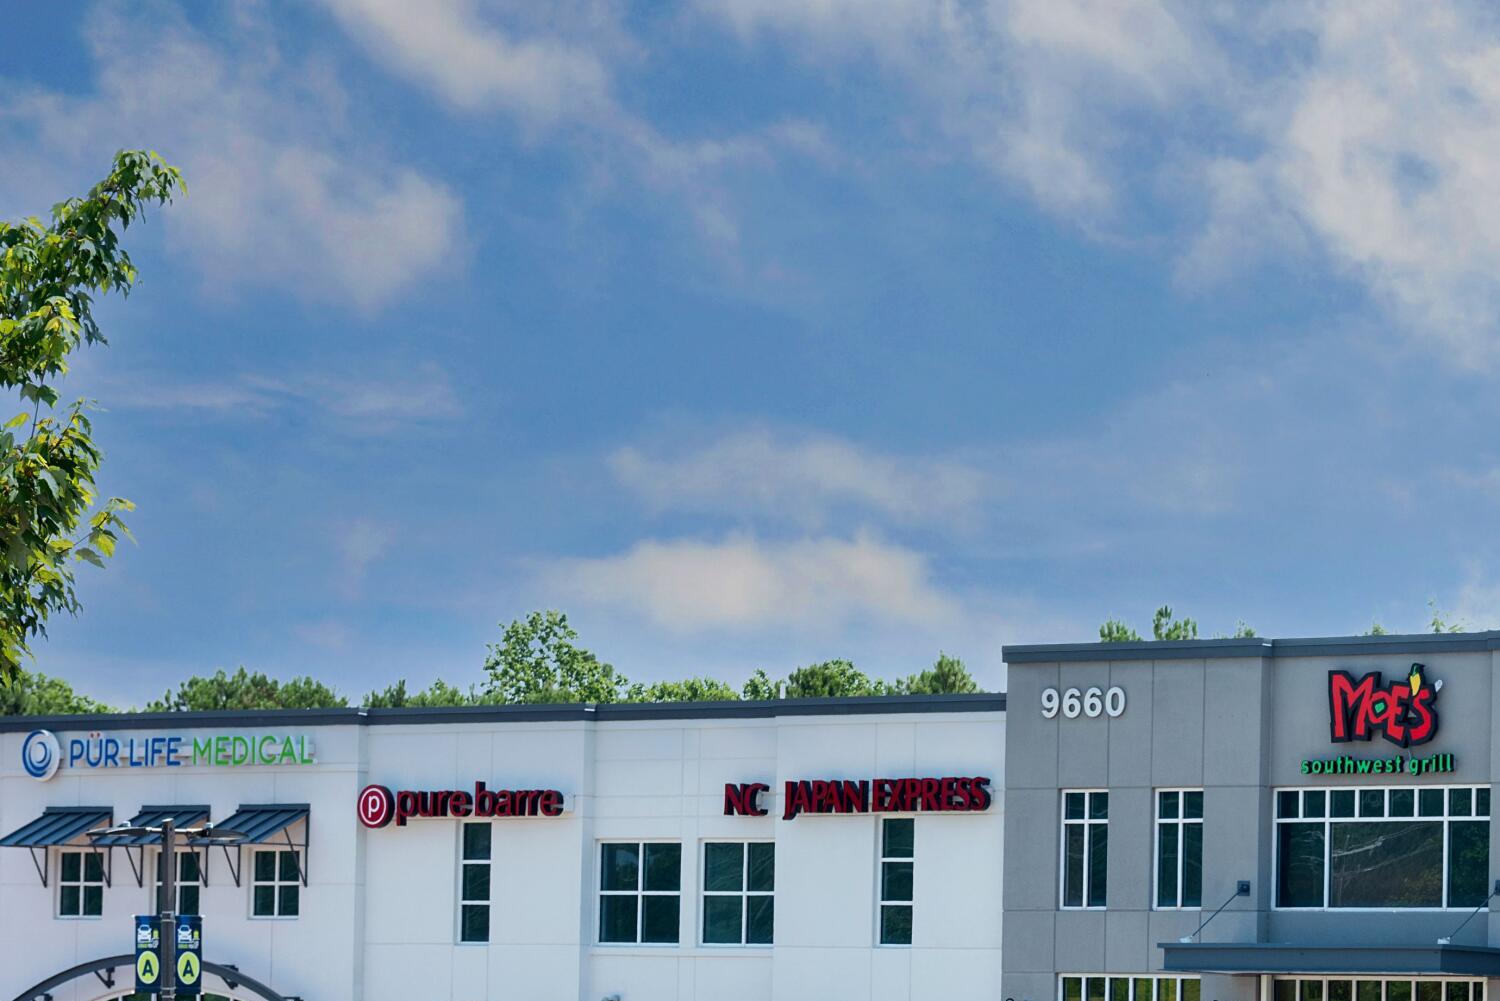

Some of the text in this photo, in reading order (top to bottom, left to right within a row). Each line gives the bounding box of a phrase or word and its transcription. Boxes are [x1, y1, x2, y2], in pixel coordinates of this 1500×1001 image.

[1040, 685, 1126, 719] 9660
[70, 732, 314, 768] PÜR LIFE MEDICAL
[1301, 753, 1454, 776] southwest grill
[396, 780, 565, 827] pure barre
[724, 776, 992, 820] NC JAPAN EXPRESS
[142, 959, 154, 977] A
[182, 959, 195, 977] A
